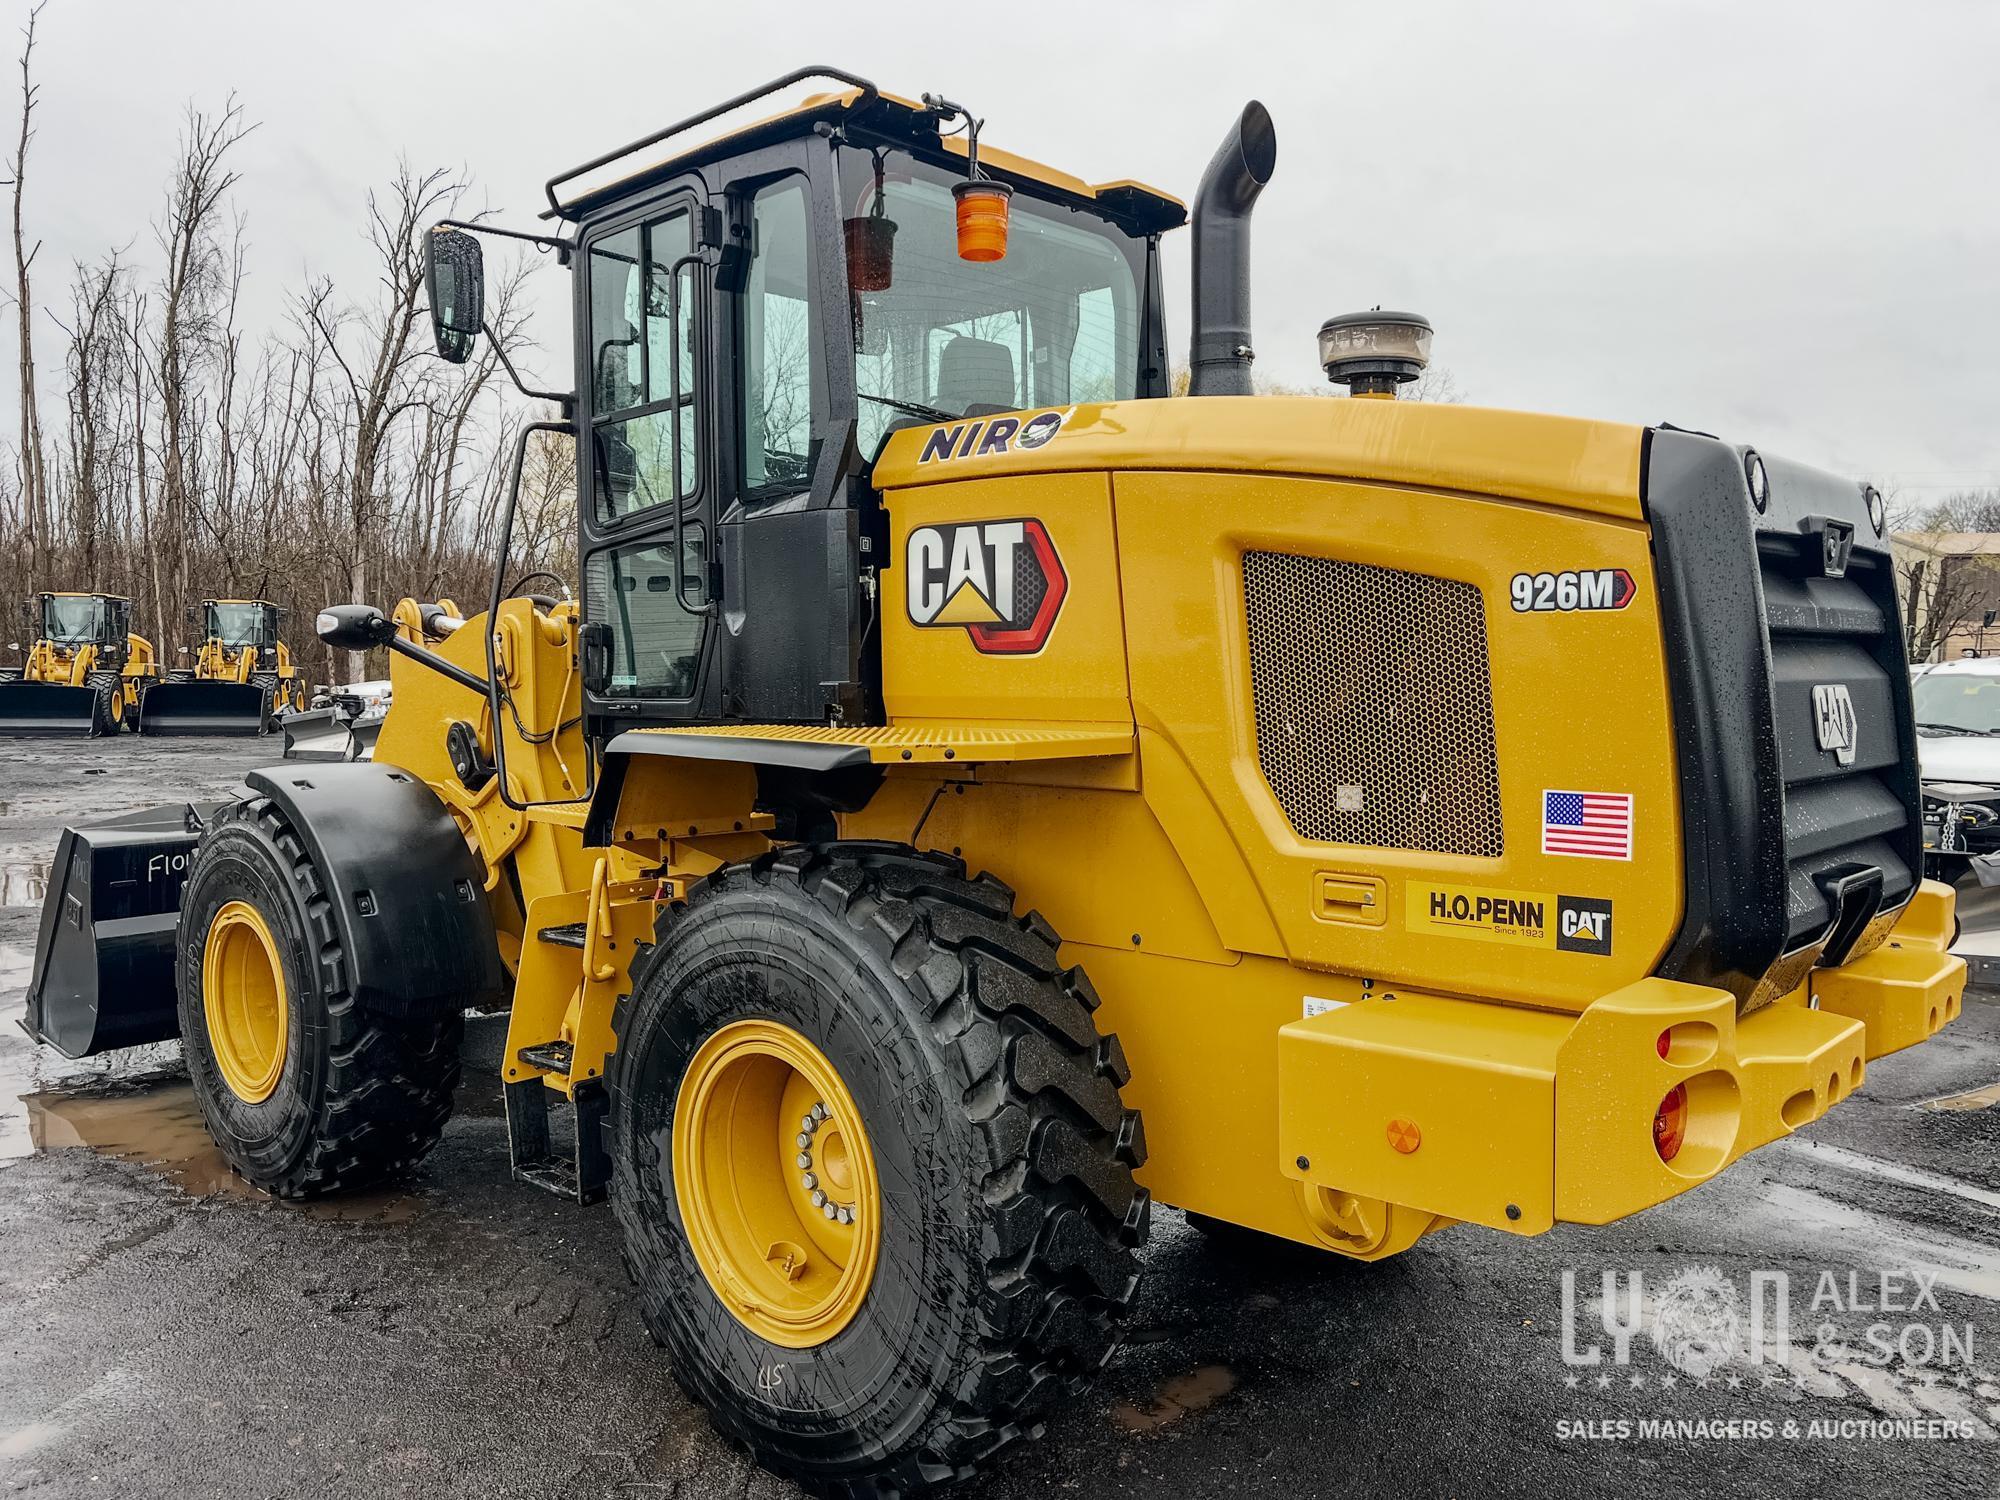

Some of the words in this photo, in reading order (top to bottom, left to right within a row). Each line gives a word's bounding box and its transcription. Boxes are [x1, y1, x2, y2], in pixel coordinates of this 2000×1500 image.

[908, 522, 1024, 624] CAT
[1511, 570, 1613, 611] 926M
[1814, 685, 1849, 749] CAT
[1430, 892, 1544, 928] H.O.PENN
[1561, 908, 1611, 941] CAT
[1494, 925, 1517, 936] Since
[1520, 928, 1544, 939] 1923
